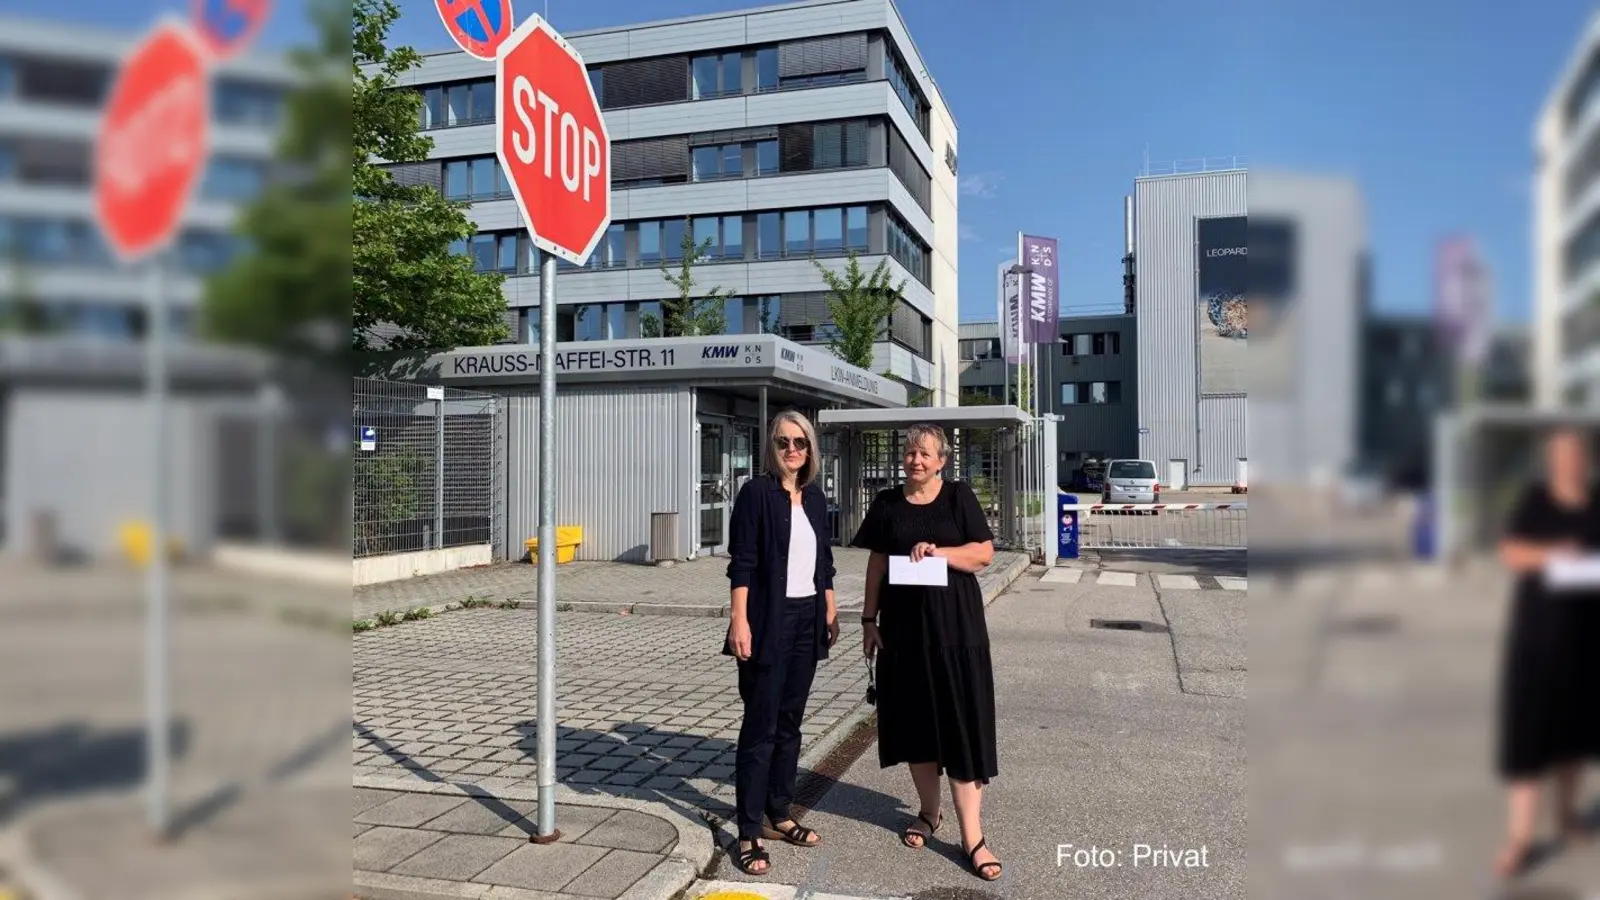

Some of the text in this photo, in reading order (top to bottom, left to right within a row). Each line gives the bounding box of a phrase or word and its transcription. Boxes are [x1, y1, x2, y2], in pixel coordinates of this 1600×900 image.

[512, 75, 600, 203] STOP
[1207, 247, 1247, 257] LEOPARD
[1031, 272, 1046, 322] KMW
[661, 348, 674, 366] 11
[702, 345, 739, 358] KMW
